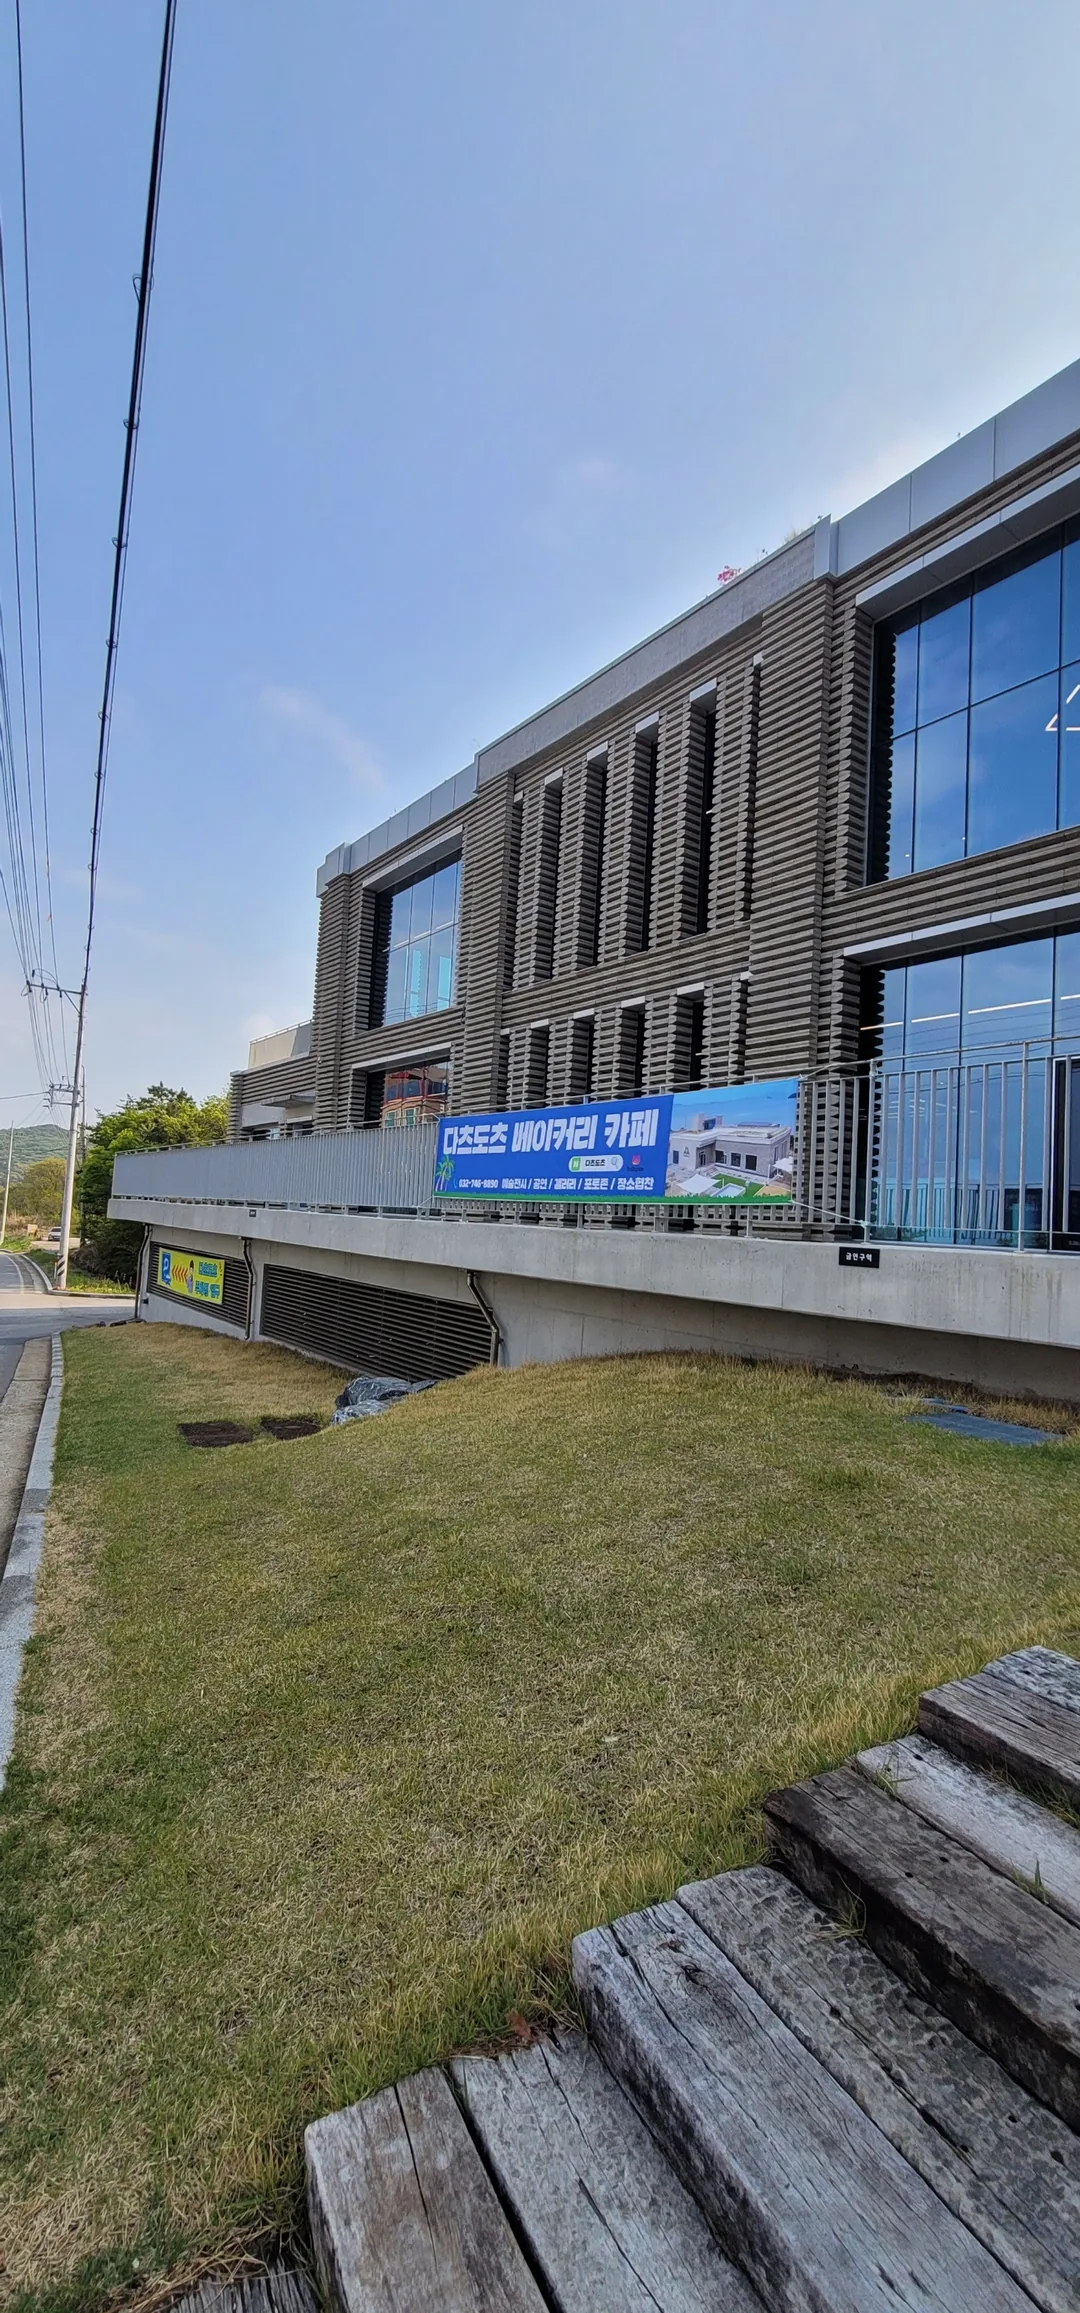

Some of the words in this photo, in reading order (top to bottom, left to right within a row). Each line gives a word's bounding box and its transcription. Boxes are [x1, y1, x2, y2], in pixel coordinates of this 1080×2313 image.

[443, 1121, 509, 1155] 다츠도츠
[511, 1114, 599, 1152] 베이커리
[604, 1108, 660, 1148] 카페
[533, 1178, 547, 1190] 공연
[553, 1177, 577, 1190] 갤러리
[583, 1177, 609, 1190] 포토존
[845, 1252, 873, 1262] 금연구역
